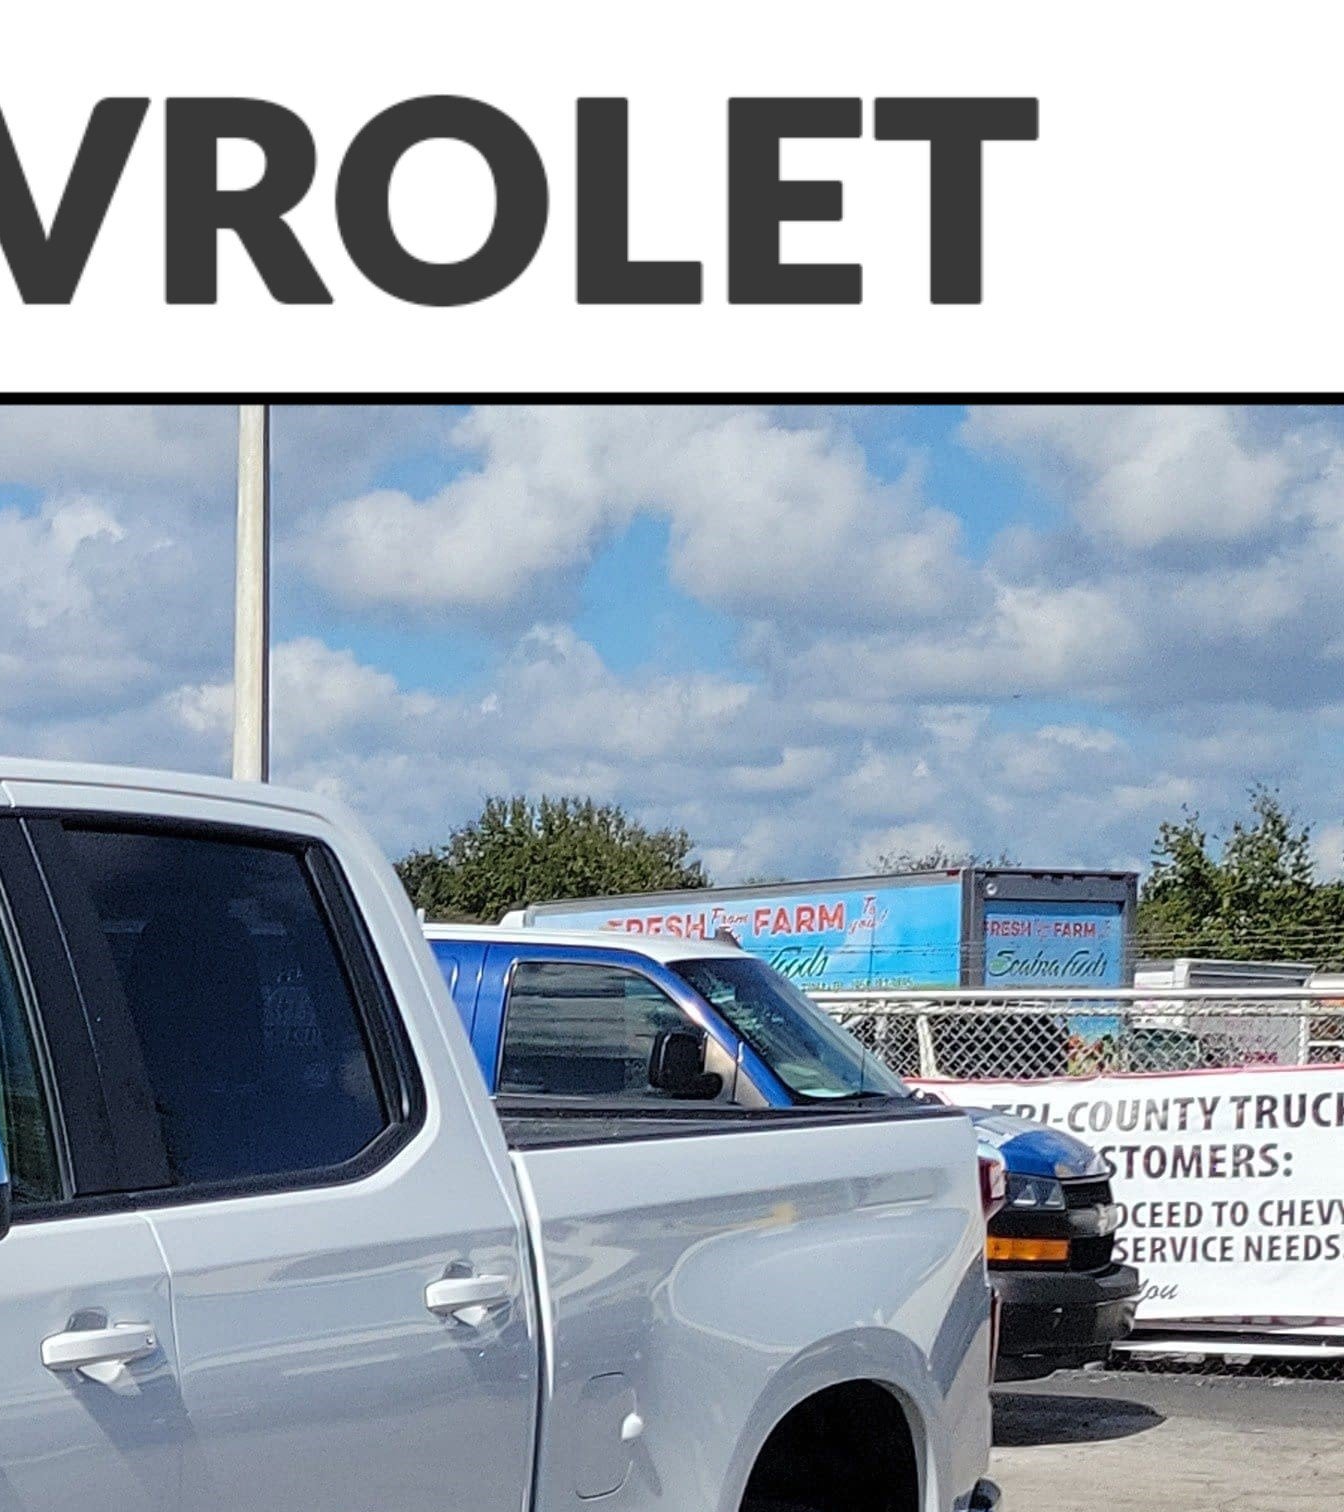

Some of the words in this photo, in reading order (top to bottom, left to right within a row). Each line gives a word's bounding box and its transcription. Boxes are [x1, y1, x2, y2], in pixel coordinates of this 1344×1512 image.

[753, 903, 844, 936] FARM
[1054, 922, 1095, 937] FARM
[1212, 1201, 1249, 1227] TO
[1113, 1235, 1233, 1263] SERVICE
